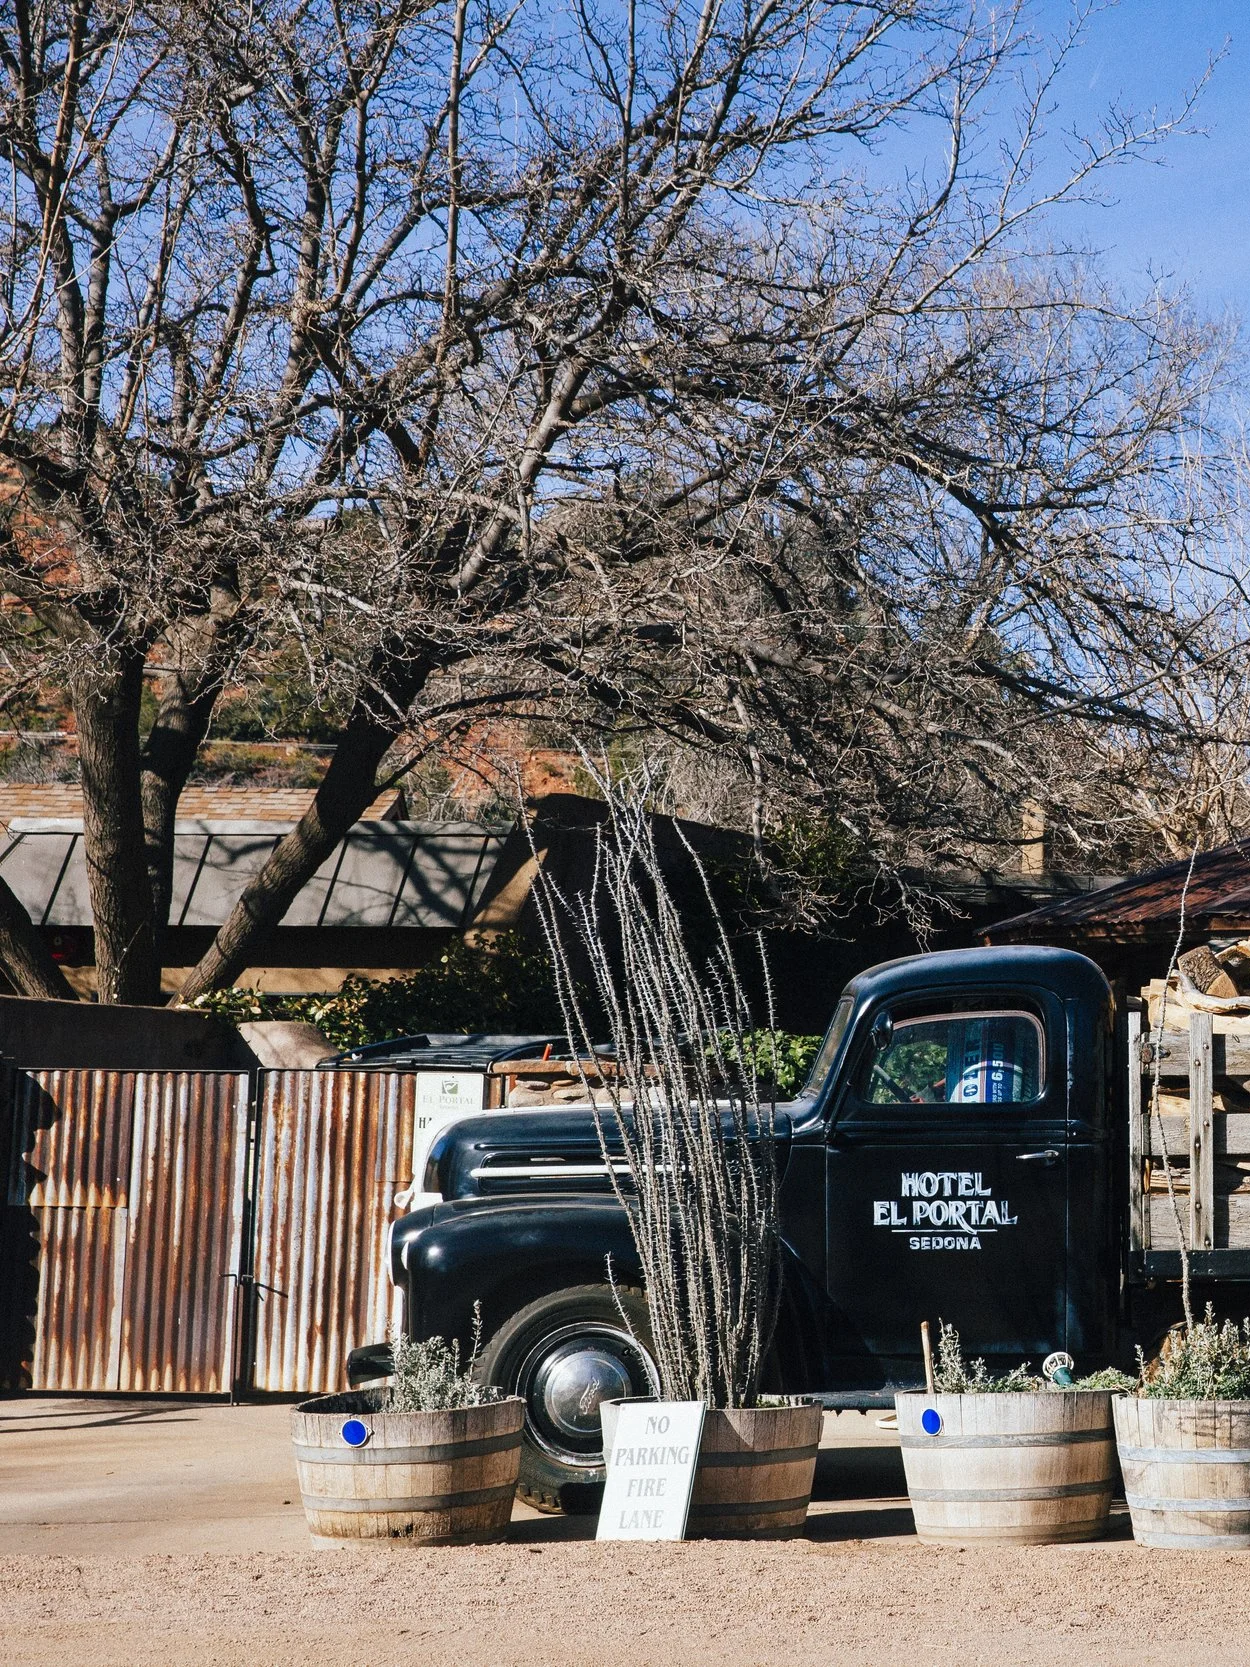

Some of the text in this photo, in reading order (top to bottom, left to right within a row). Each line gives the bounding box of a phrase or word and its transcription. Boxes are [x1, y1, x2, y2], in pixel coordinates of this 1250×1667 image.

[439, 1095, 475, 1105] PORTAL
[901, 1172, 992, 1198] HOTEL
[873, 1200, 1019, 1235] EL PORTAL
[909, 1236, 982, 1250] SEDONA
[645, 1415, 671, 1435] NO
[615, 1446, 690, 1467] PARKING
[627, 1478, 667, 1497] FIRE
[618, 1509, 665, 1530] LANE
